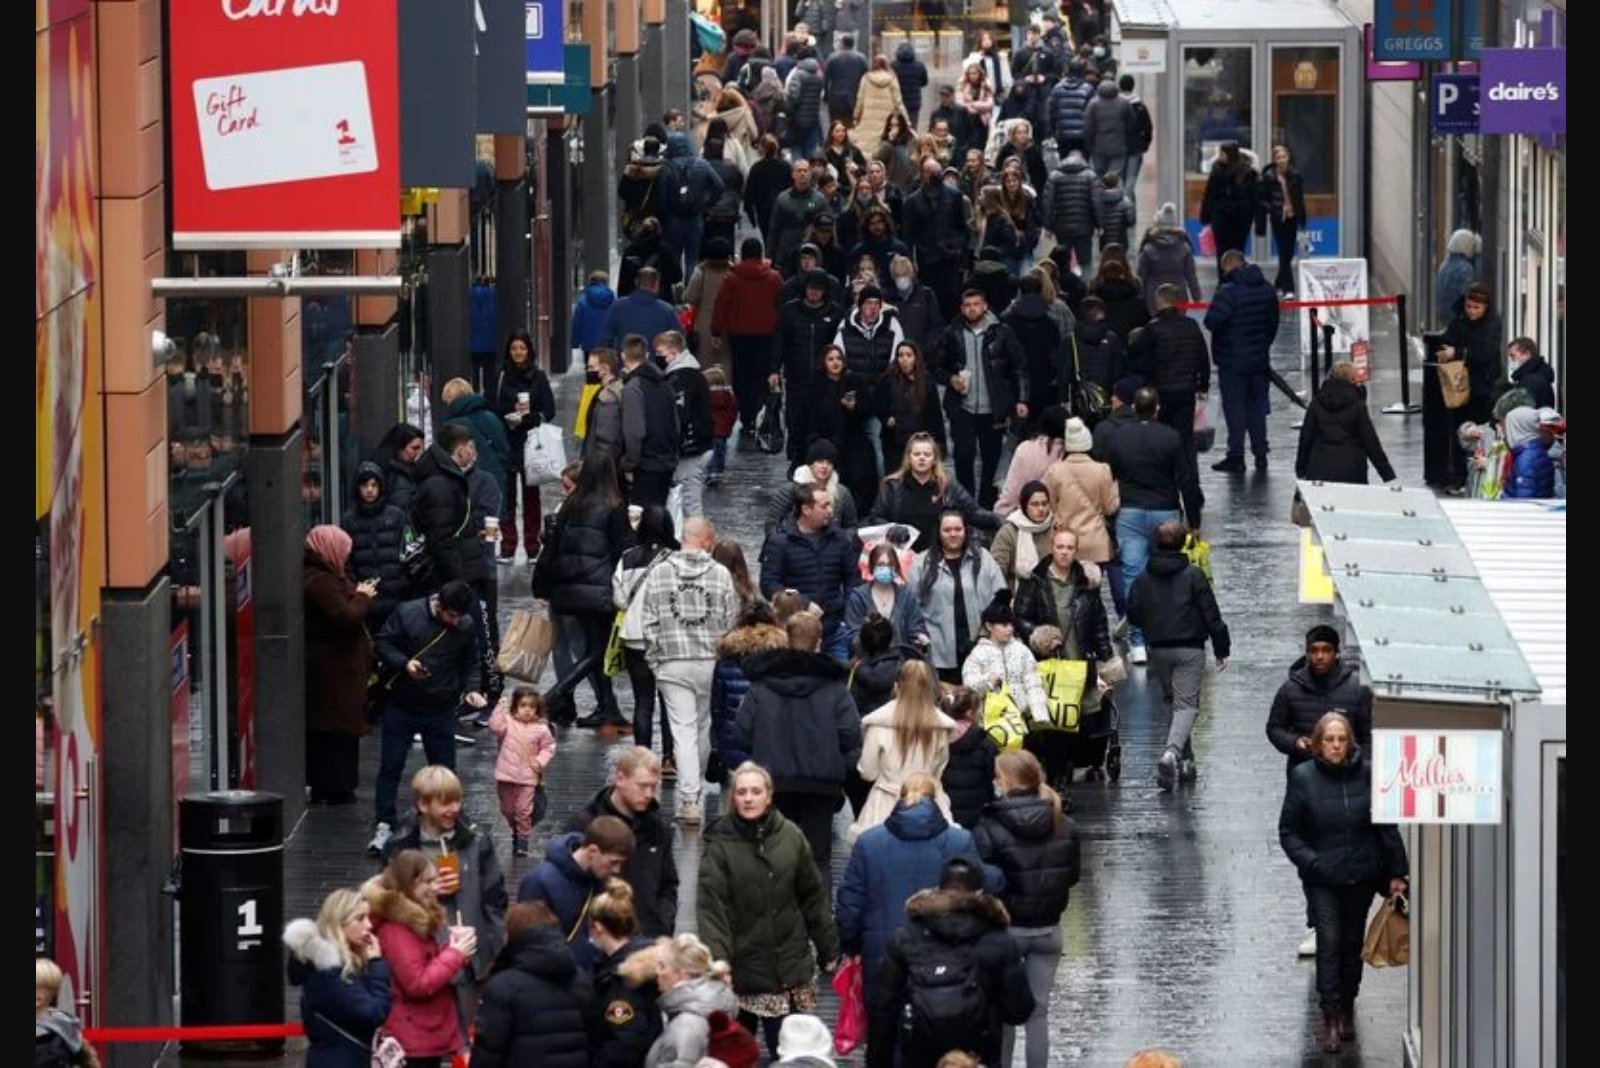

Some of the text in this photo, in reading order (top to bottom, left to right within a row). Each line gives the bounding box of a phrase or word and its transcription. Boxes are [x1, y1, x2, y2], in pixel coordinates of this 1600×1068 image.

[1383, 37, 1444, 51] GREGGS
[206, 85, 246, 118] Gift
[1438, 83, 1459, 115] P
[1488, 82, 1559, 101] claire's
[217, 107, 259, 136] Card
[336, 119, 356, 144] 1
[237, 899, 263, 935] 1
